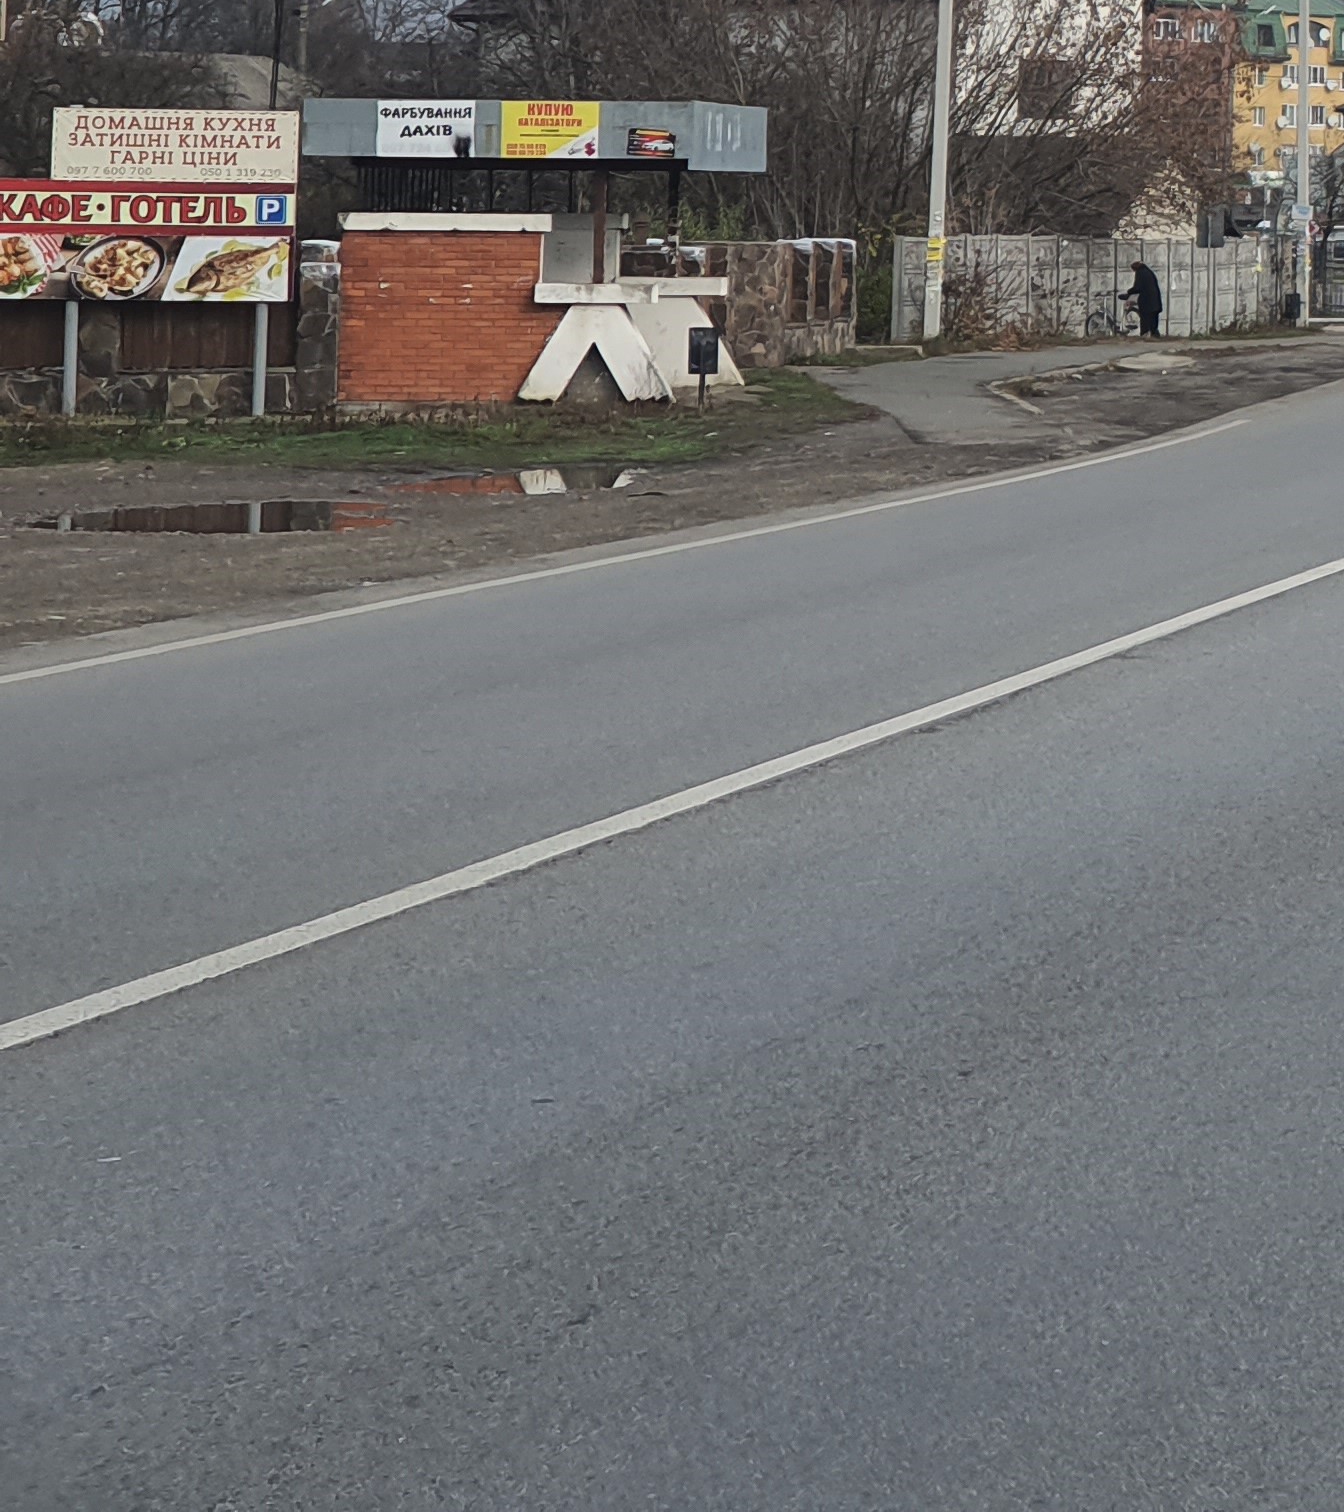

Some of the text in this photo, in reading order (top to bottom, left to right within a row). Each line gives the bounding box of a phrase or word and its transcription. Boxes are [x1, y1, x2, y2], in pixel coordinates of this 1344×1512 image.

[380, 107, 473, 119] ФАРБУВАННЯ
[527, 103, 574, 116] КУПУЮ
[74, 116, 276, 132] ДОМАШНЯ КУХНЯ
[400, 124, 453, 138] ДАХІВ
[68, 133, 281, 150] ЗАТИШНІ КІМНАТИ
[109, 150, 238, 168] ГАРНІ ЦІНИ
[66, 166, 88, 175] 097
[92, 166, 99, 175] 7
[103, 166, 126, 175] 600
[130, 166, 152, 175] 700
[200, 167, 222, 176] 050
[226, 168, 232, 176] 1
[0, 193, 247, 224] КАФЕ ГОТЕЛЬ
[262, 200, 281, 221] P
